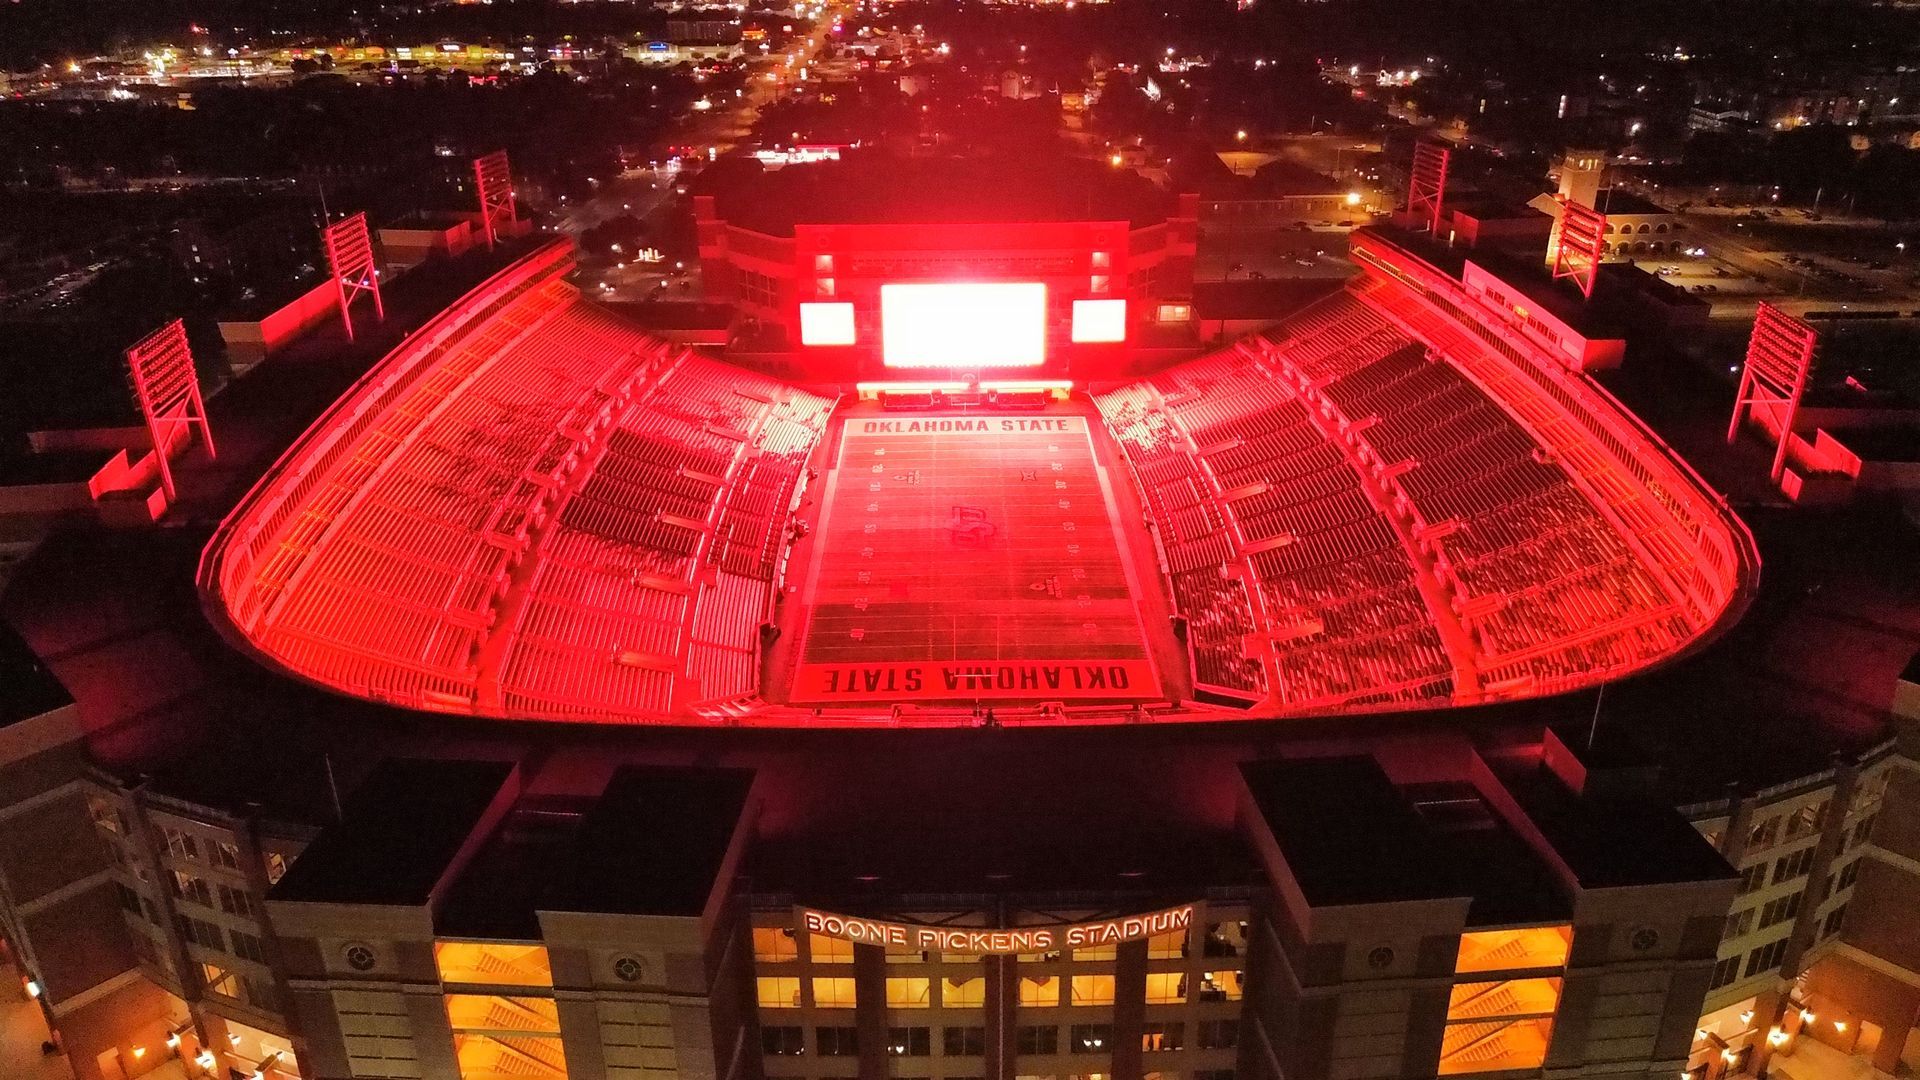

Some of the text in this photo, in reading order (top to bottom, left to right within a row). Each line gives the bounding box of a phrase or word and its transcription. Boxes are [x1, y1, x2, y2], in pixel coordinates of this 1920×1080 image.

[864, 419, 1069, 433] OKLAHOMA STATE
[822, 666, 1129, 693] OKLAHOMA STATE
[806, 907, 1193, 952] BOONE PICKENS STADIUM
